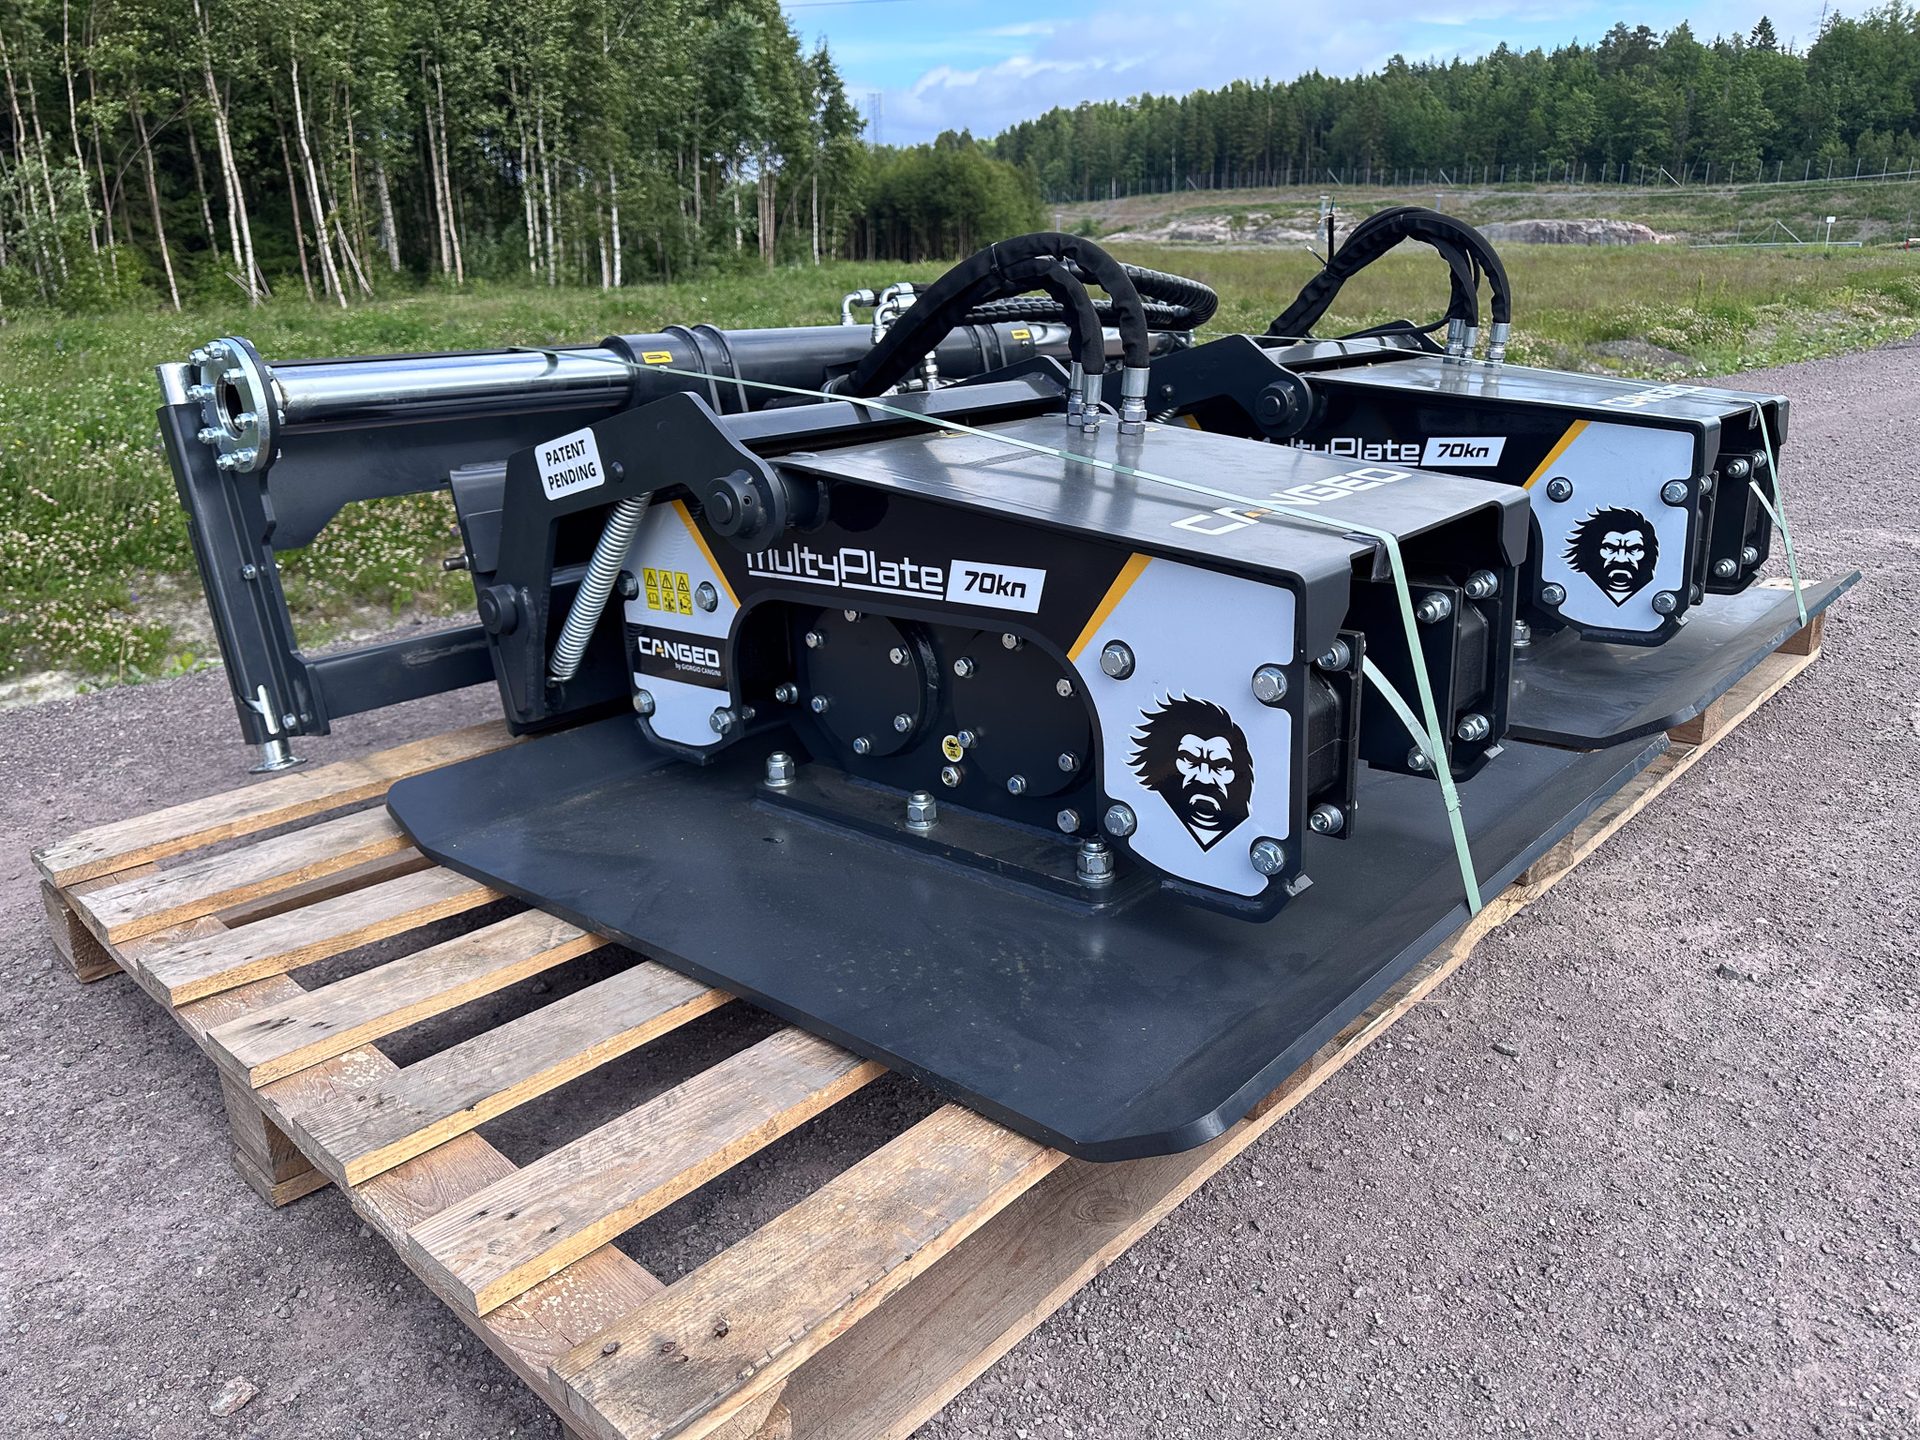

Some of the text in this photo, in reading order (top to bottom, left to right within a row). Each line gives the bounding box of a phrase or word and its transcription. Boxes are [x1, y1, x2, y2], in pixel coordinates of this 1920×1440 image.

[545, 439, 586, 467] PATENT
[1247, 436, 1490, 465] tPlate 70kn
[547, 461, 597, 491] PENDING
[964, 570, 1027, 598] 70kn
[638, 636, 720, 668] CANGEO
[675, 662, 682, 671] by
[681, 663, 701, 673] GIORGIO
